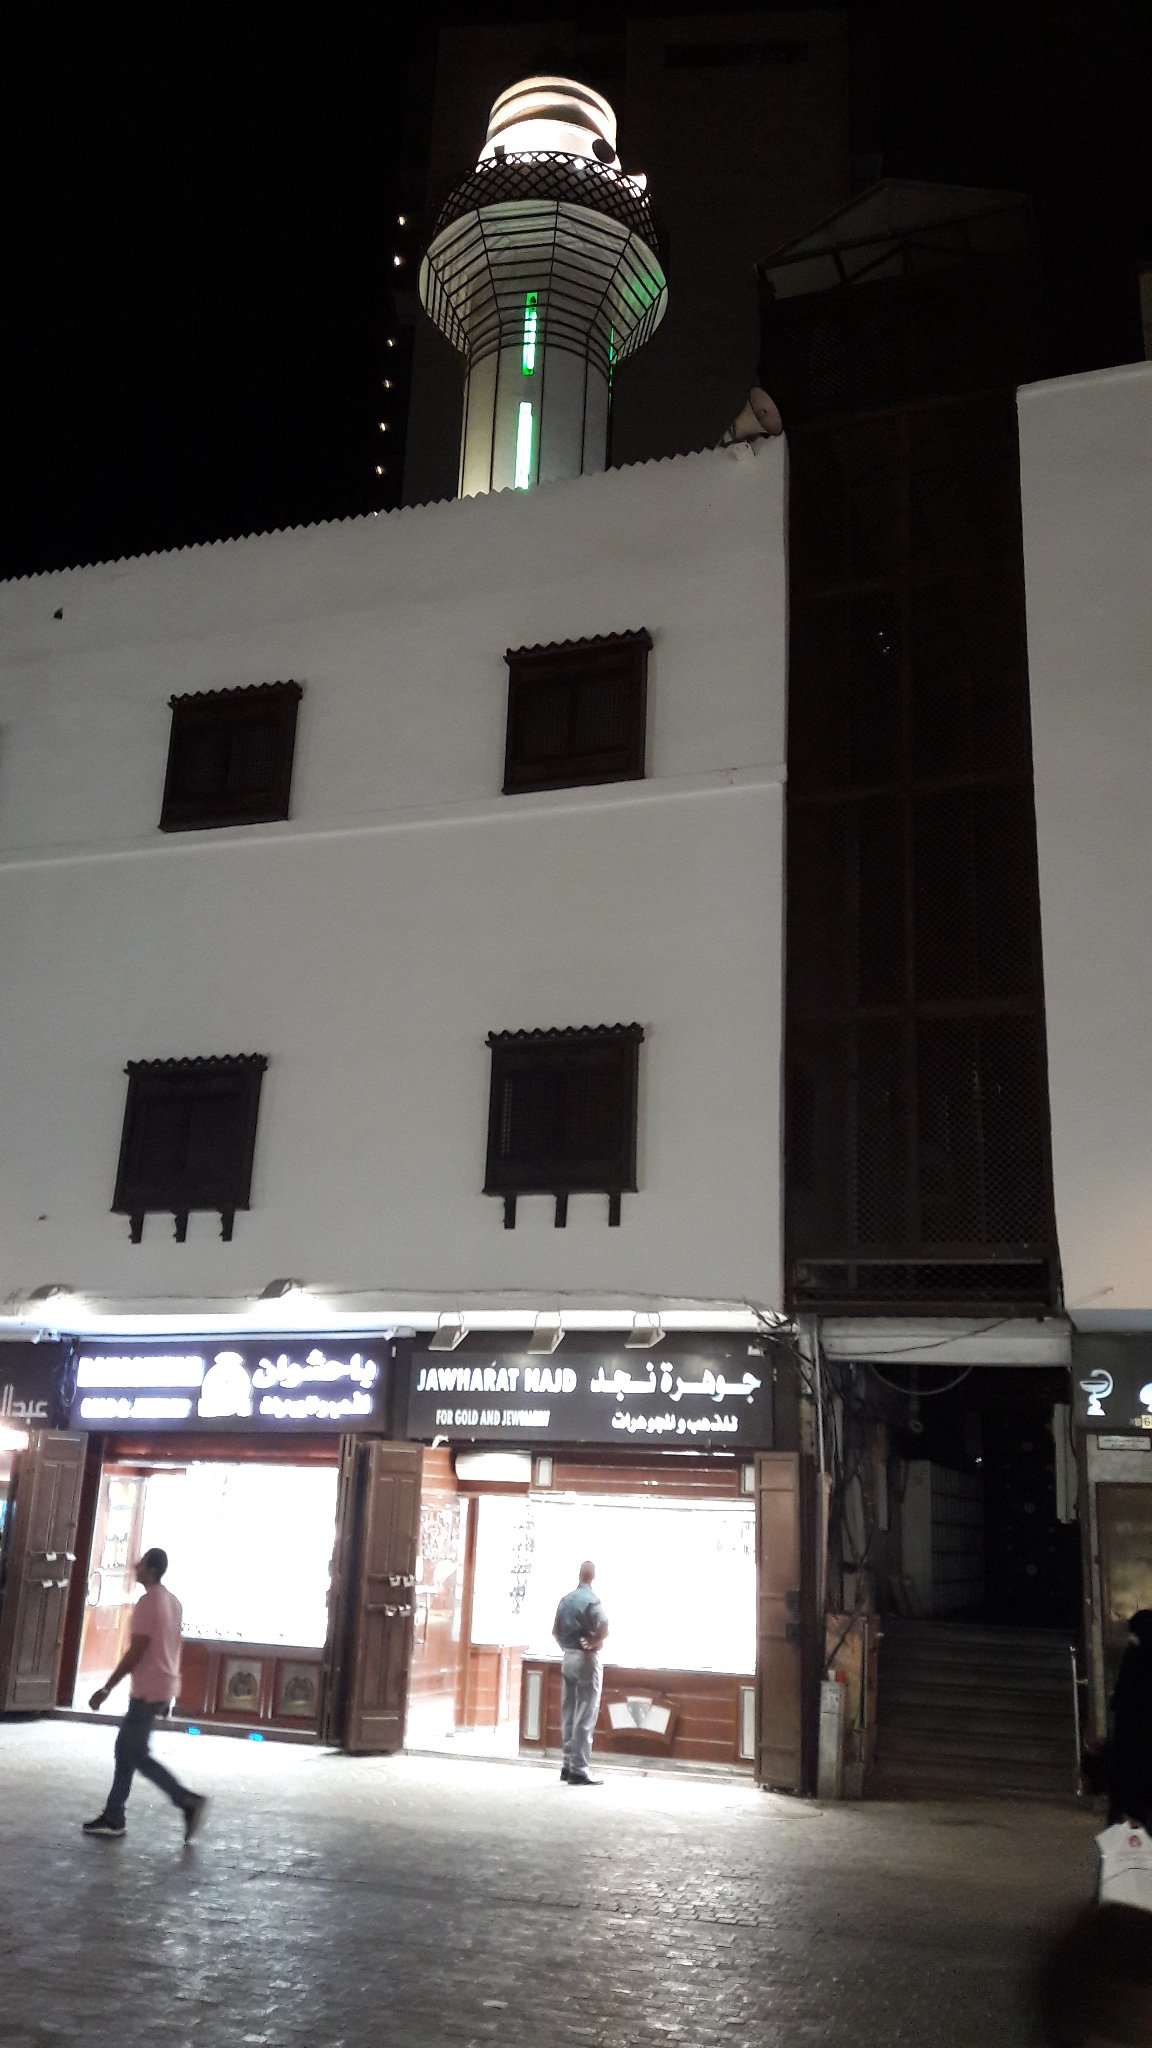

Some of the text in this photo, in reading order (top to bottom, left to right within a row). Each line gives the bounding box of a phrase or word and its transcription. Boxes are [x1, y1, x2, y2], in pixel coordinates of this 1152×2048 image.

[416, 1367, 578, 1394] JAWHARAT NAJD
[590, 1358, 762, 1404] جوهرة نجد
[435, 1408, 454, 1426] FOR
[455, 1408, 479, 1426] GOLD
[480, 1408, 501, 1427] AND
[687, 1413, 739, 1435] للذهب
